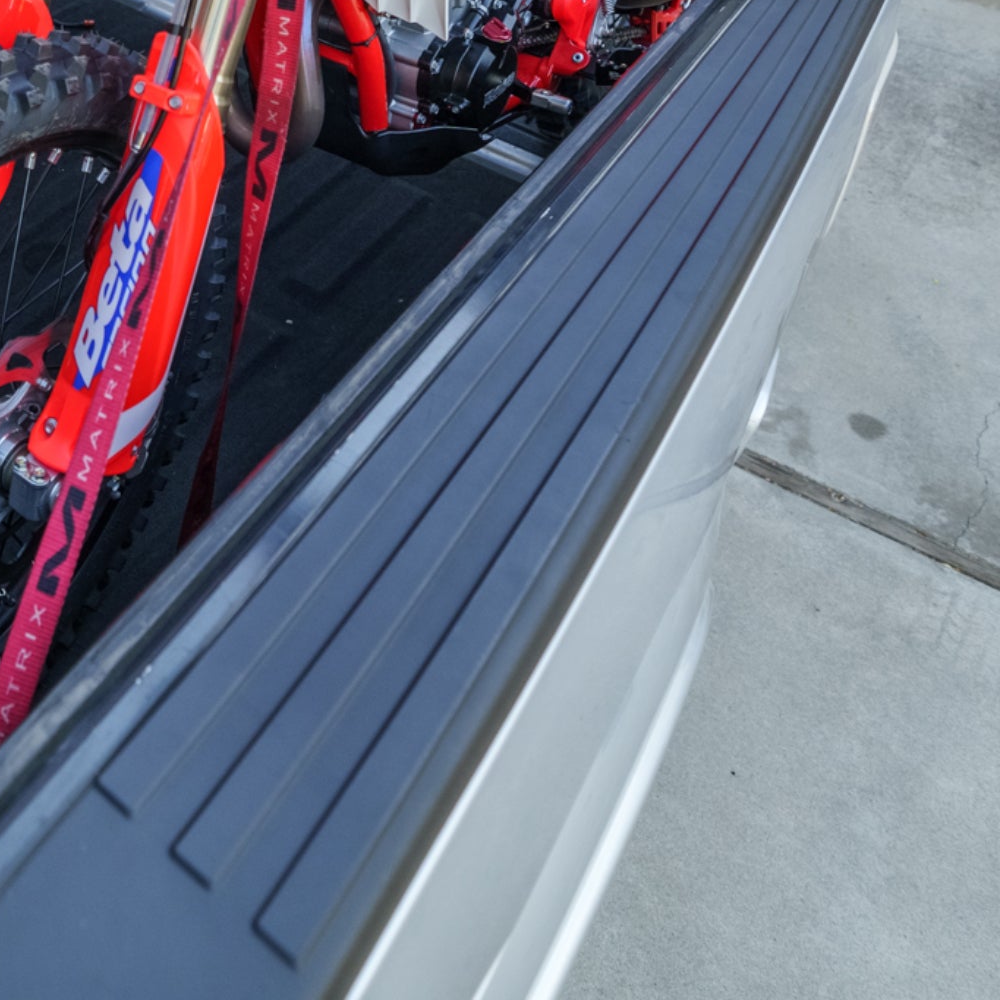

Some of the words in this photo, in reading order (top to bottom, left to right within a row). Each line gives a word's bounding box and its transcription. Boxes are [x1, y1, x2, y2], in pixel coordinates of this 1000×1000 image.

[266, 16, 291, 124] MATRIX
[74, 177, 153, 389] Beta
[77, 338, 131, 483] MATRIX
